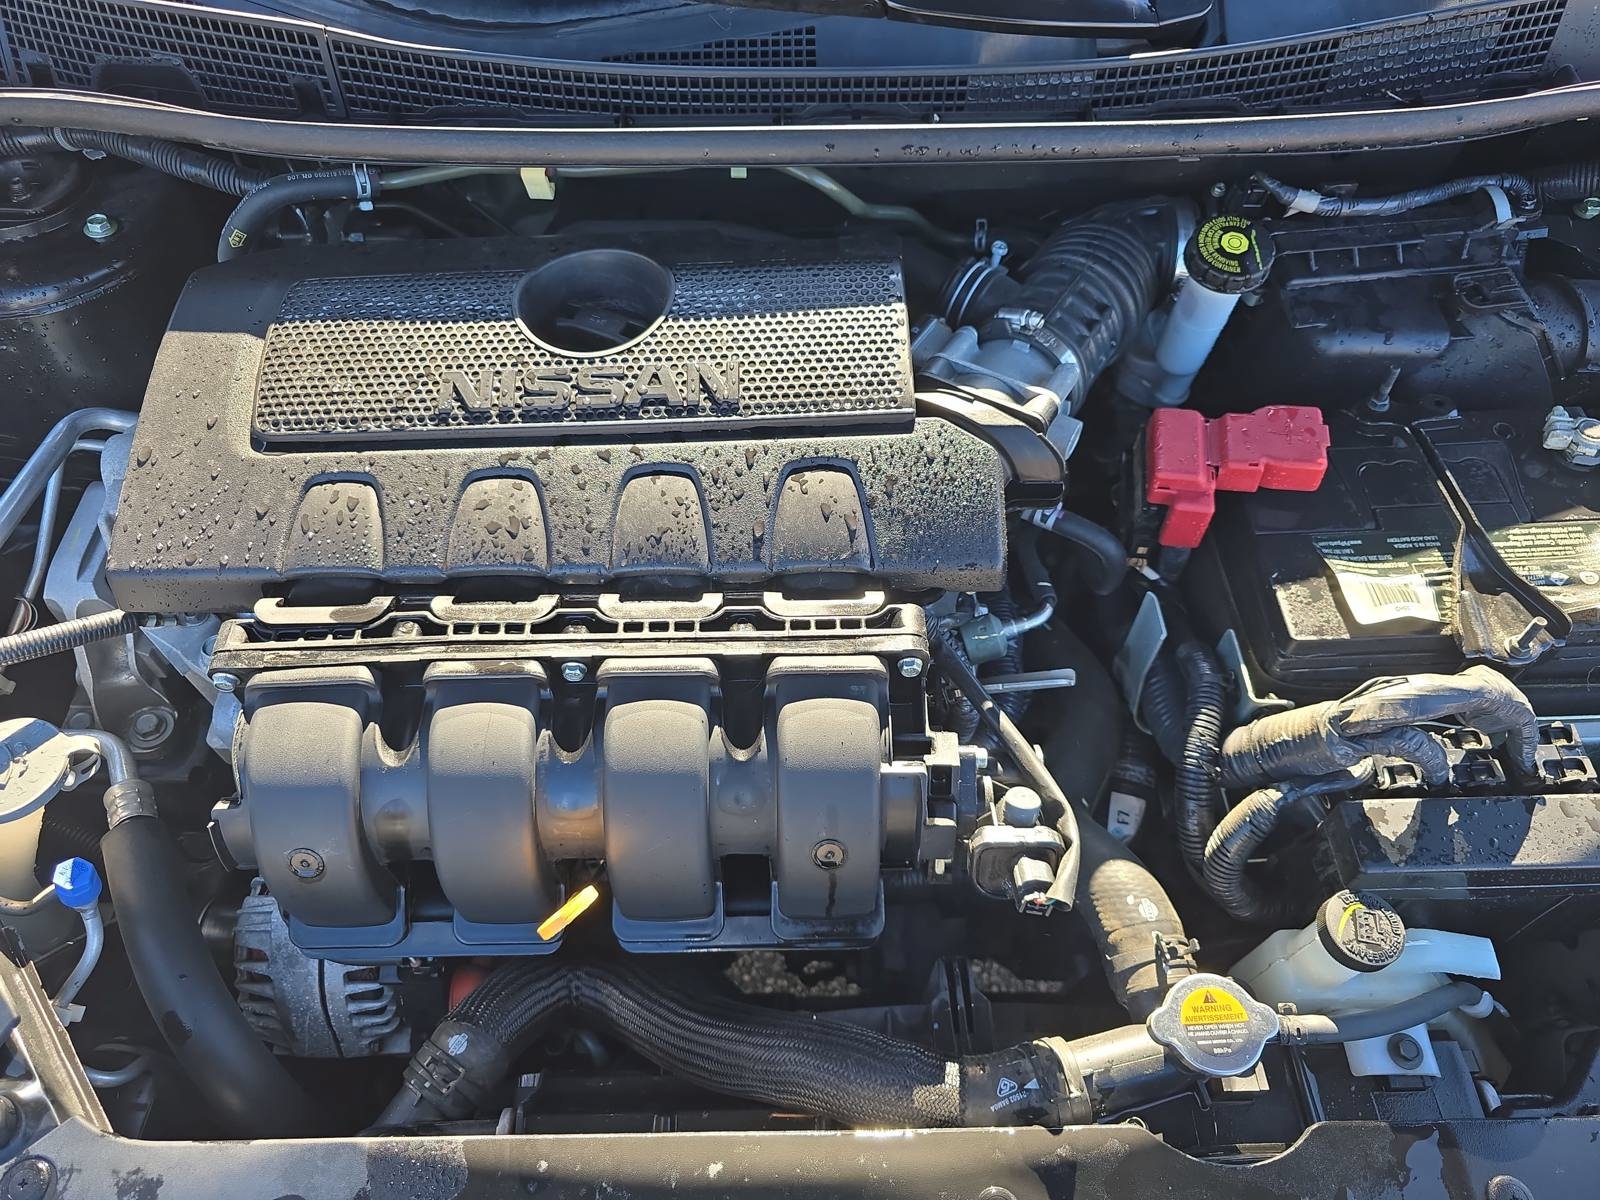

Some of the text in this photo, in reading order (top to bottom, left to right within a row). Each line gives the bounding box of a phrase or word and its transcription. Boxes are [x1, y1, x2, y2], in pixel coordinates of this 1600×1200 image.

[1211, 260, 1241, 273] CONTAINER
[437, 362, 740, 410] NISSAN
[1191, 1003, 1232, 1014] WARNING
[1184, 1012, 1244, 1023] AVERTISSEMENT
